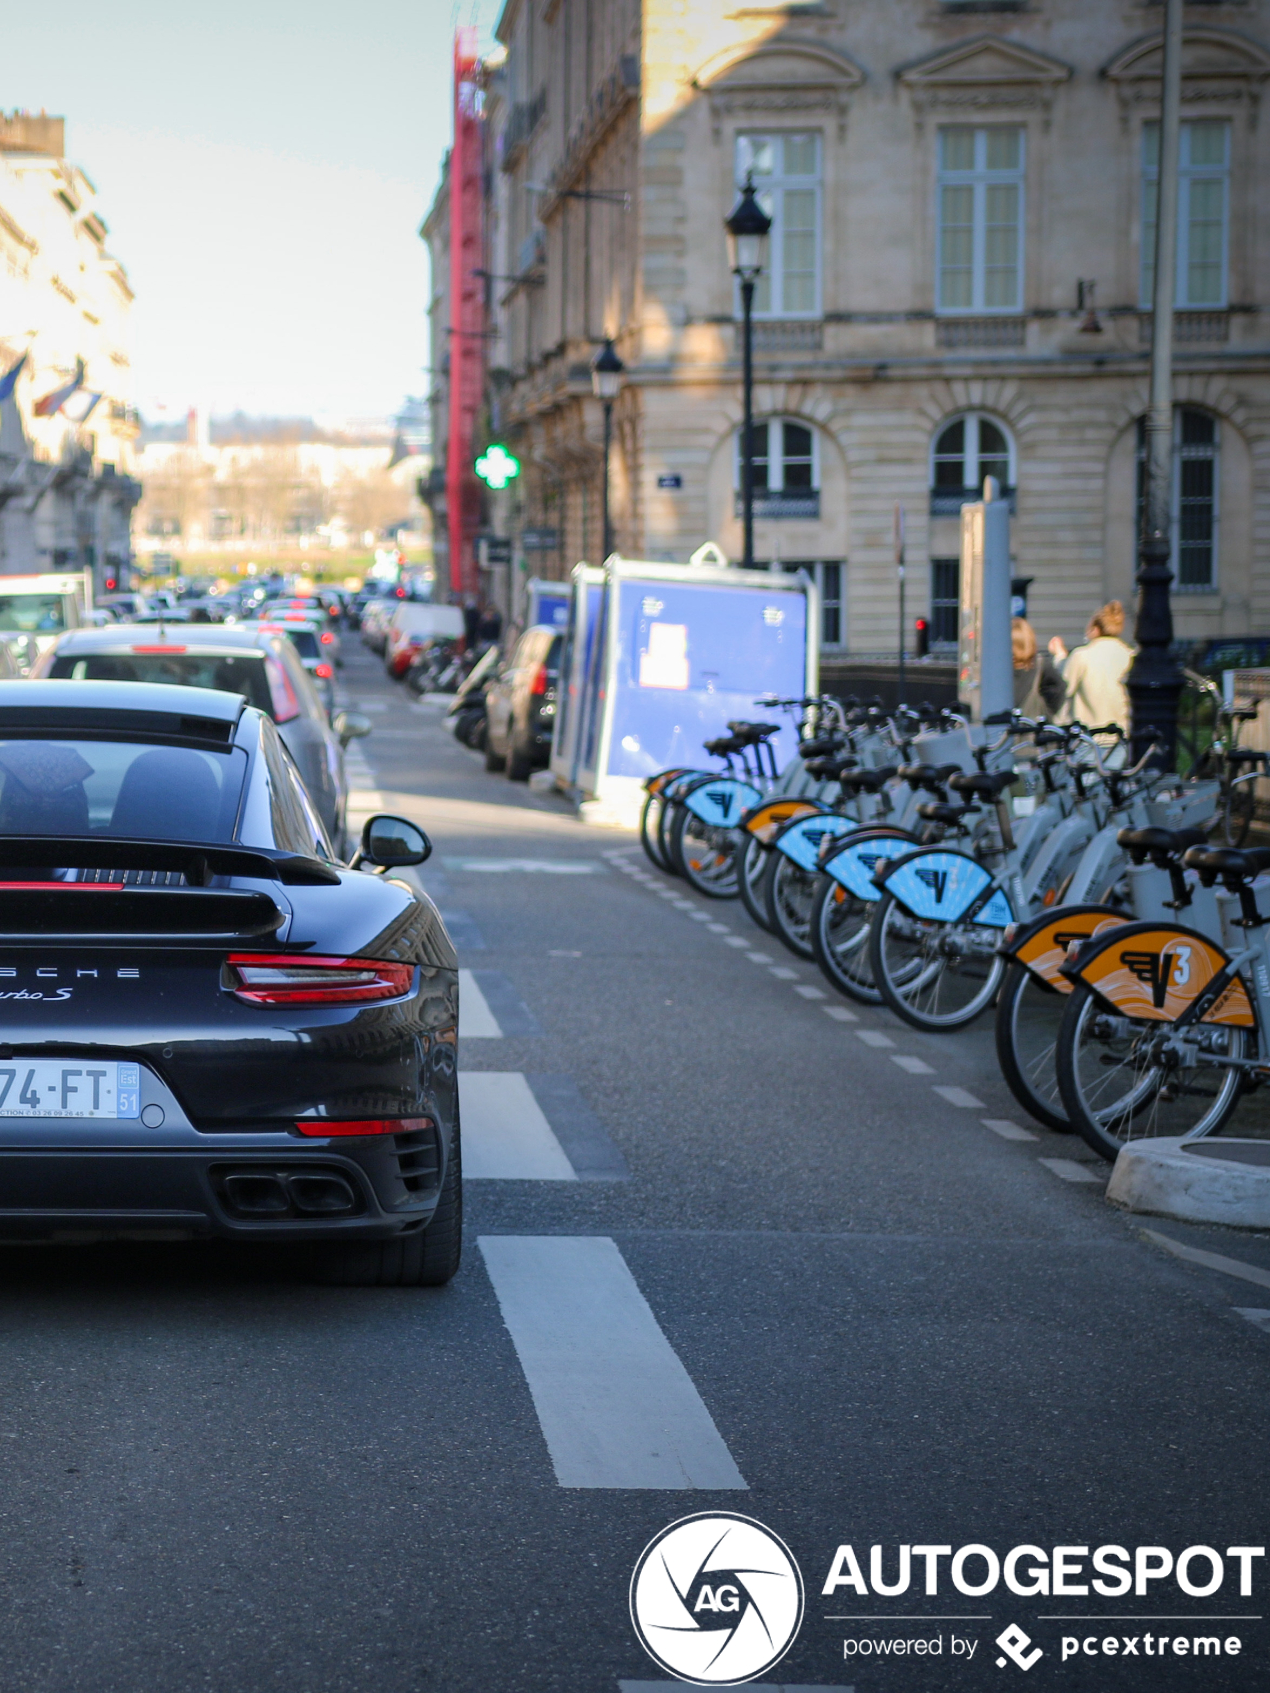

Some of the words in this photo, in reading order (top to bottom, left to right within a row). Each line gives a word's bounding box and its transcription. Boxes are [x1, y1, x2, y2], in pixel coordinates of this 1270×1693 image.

[42, 987, 73, 1001] S
[120, 1075, 137, 1085] Est
[119, 1093, 137, 1111] 51
